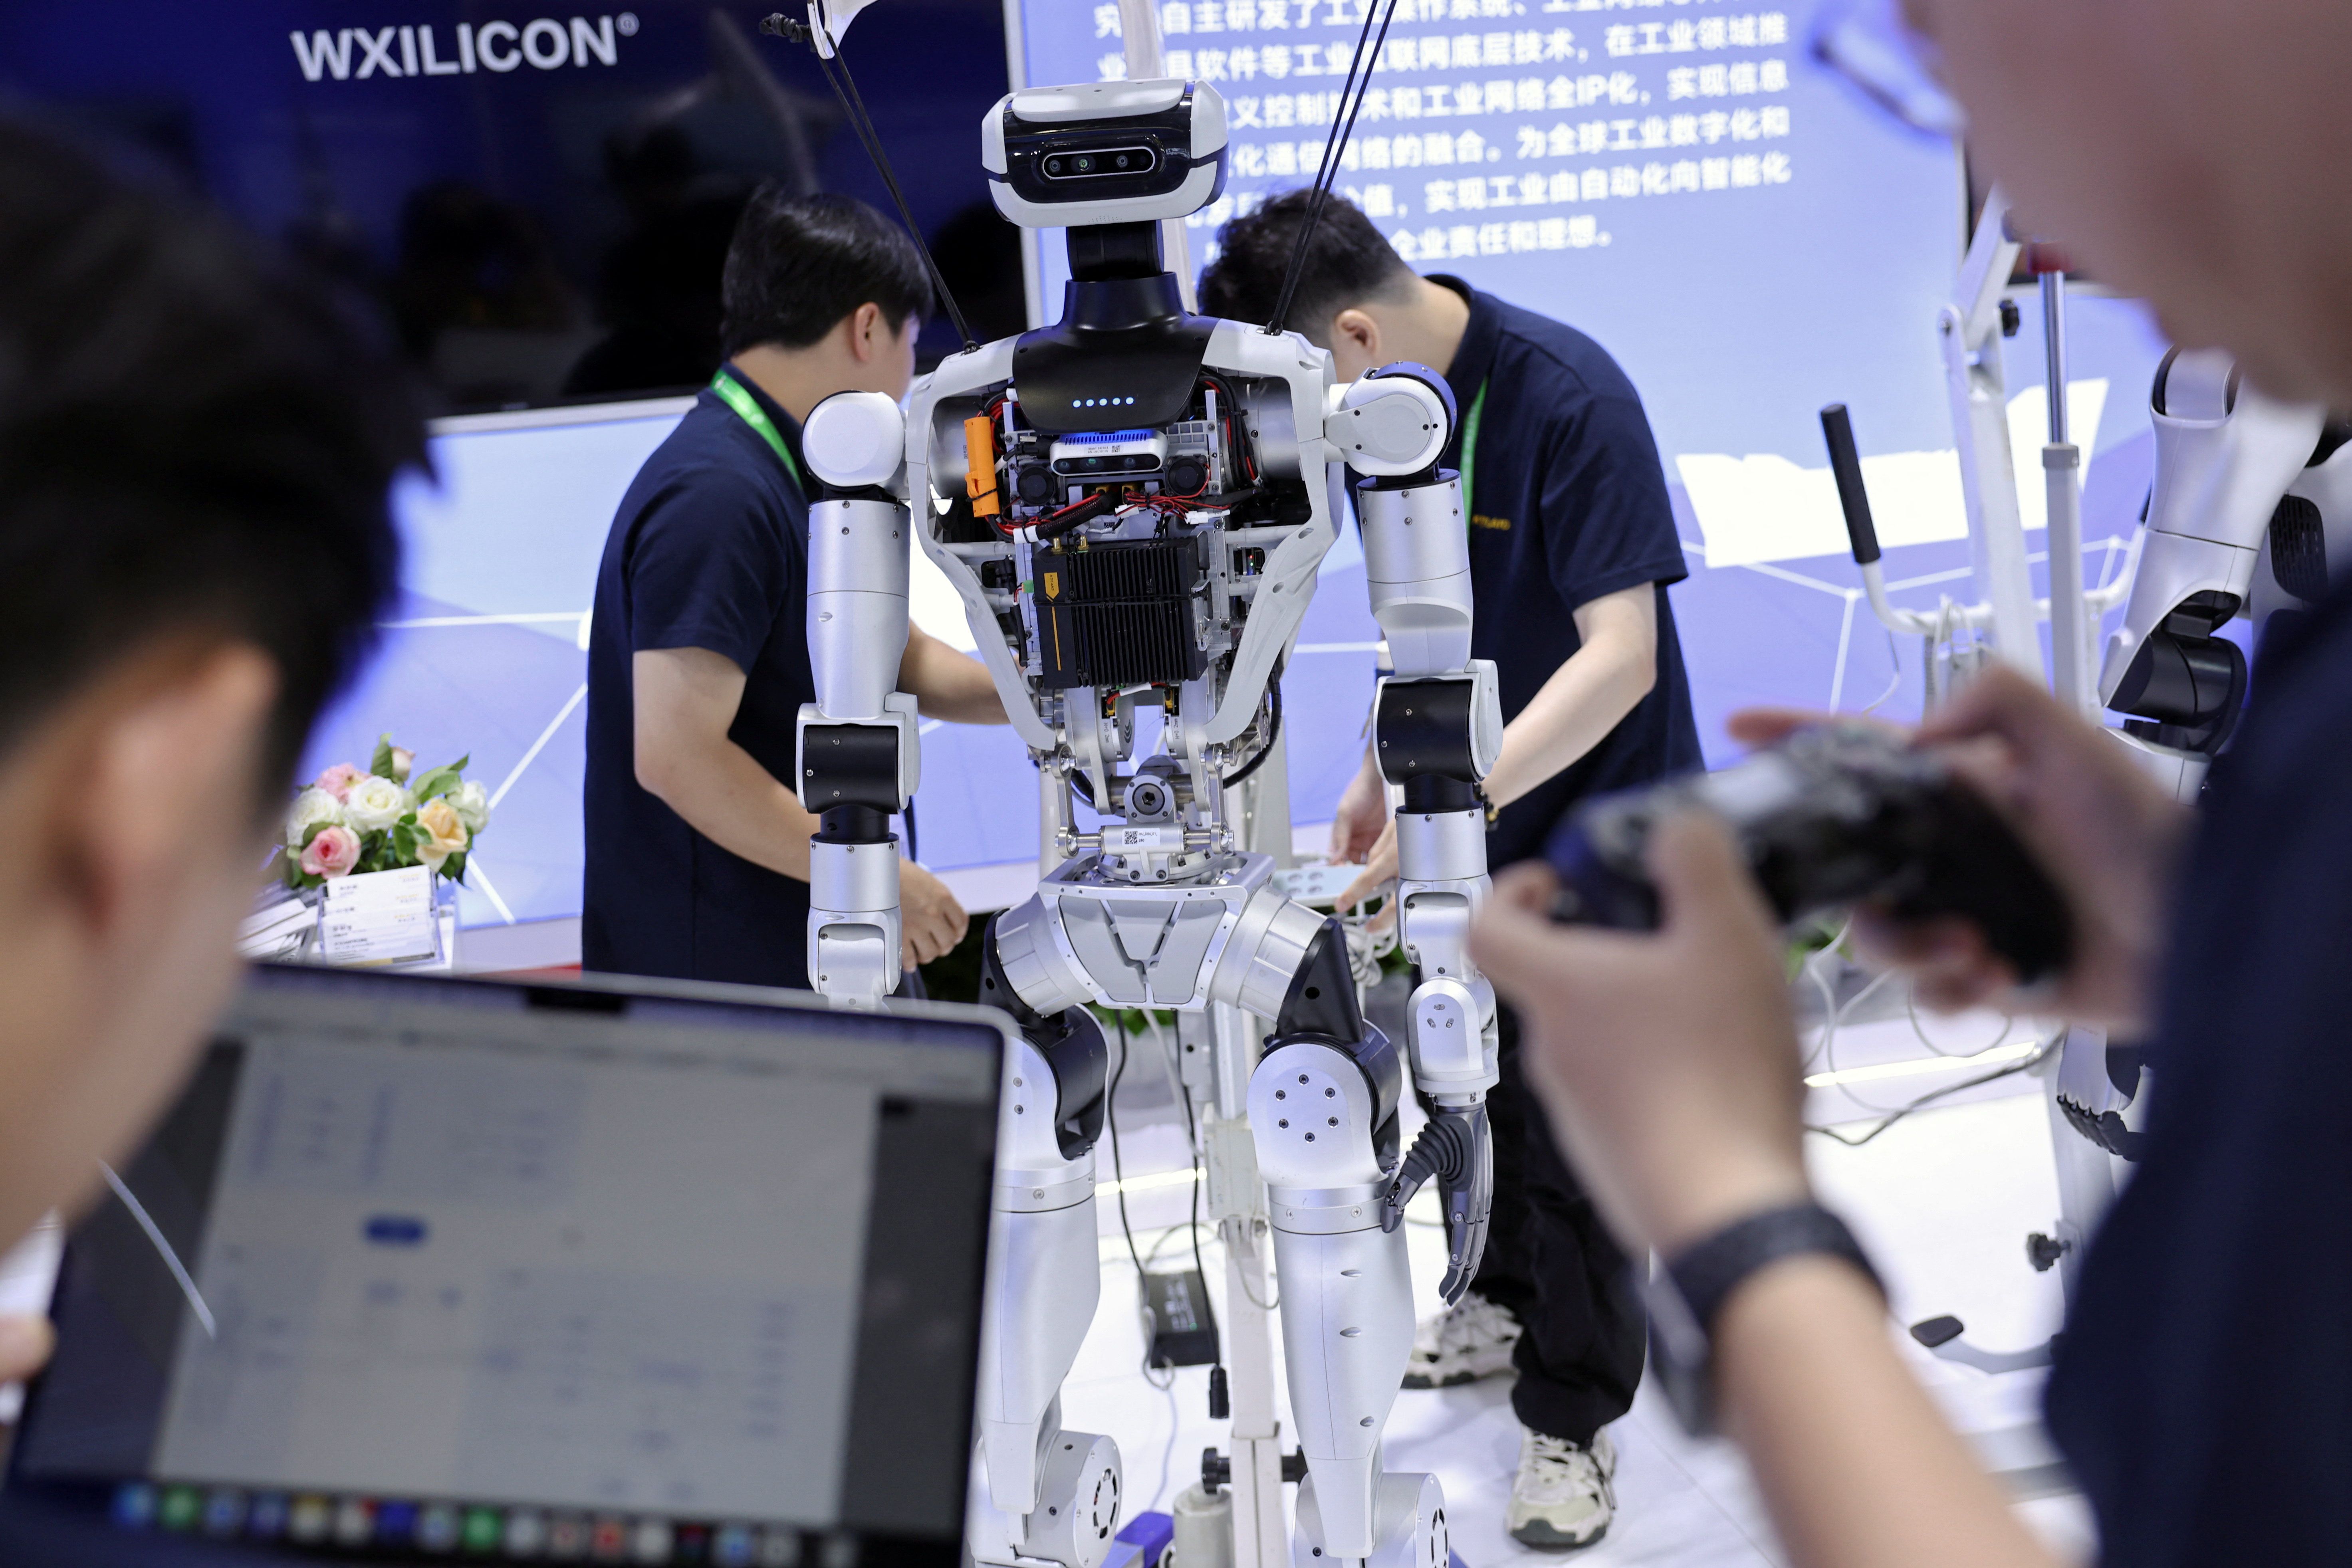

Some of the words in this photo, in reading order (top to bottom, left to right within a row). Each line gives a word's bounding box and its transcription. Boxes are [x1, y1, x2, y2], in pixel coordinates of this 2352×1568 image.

[1097, 11, 1789, 82] 业具软件等工业互联网底层技术，在工业领域推
[1223, 58, 1790, 129] 义控制技术和工业网络全IP化，实现信息
[1228, 105, 1790, 178] 化通信网络的融合。为全球工业数字化和
